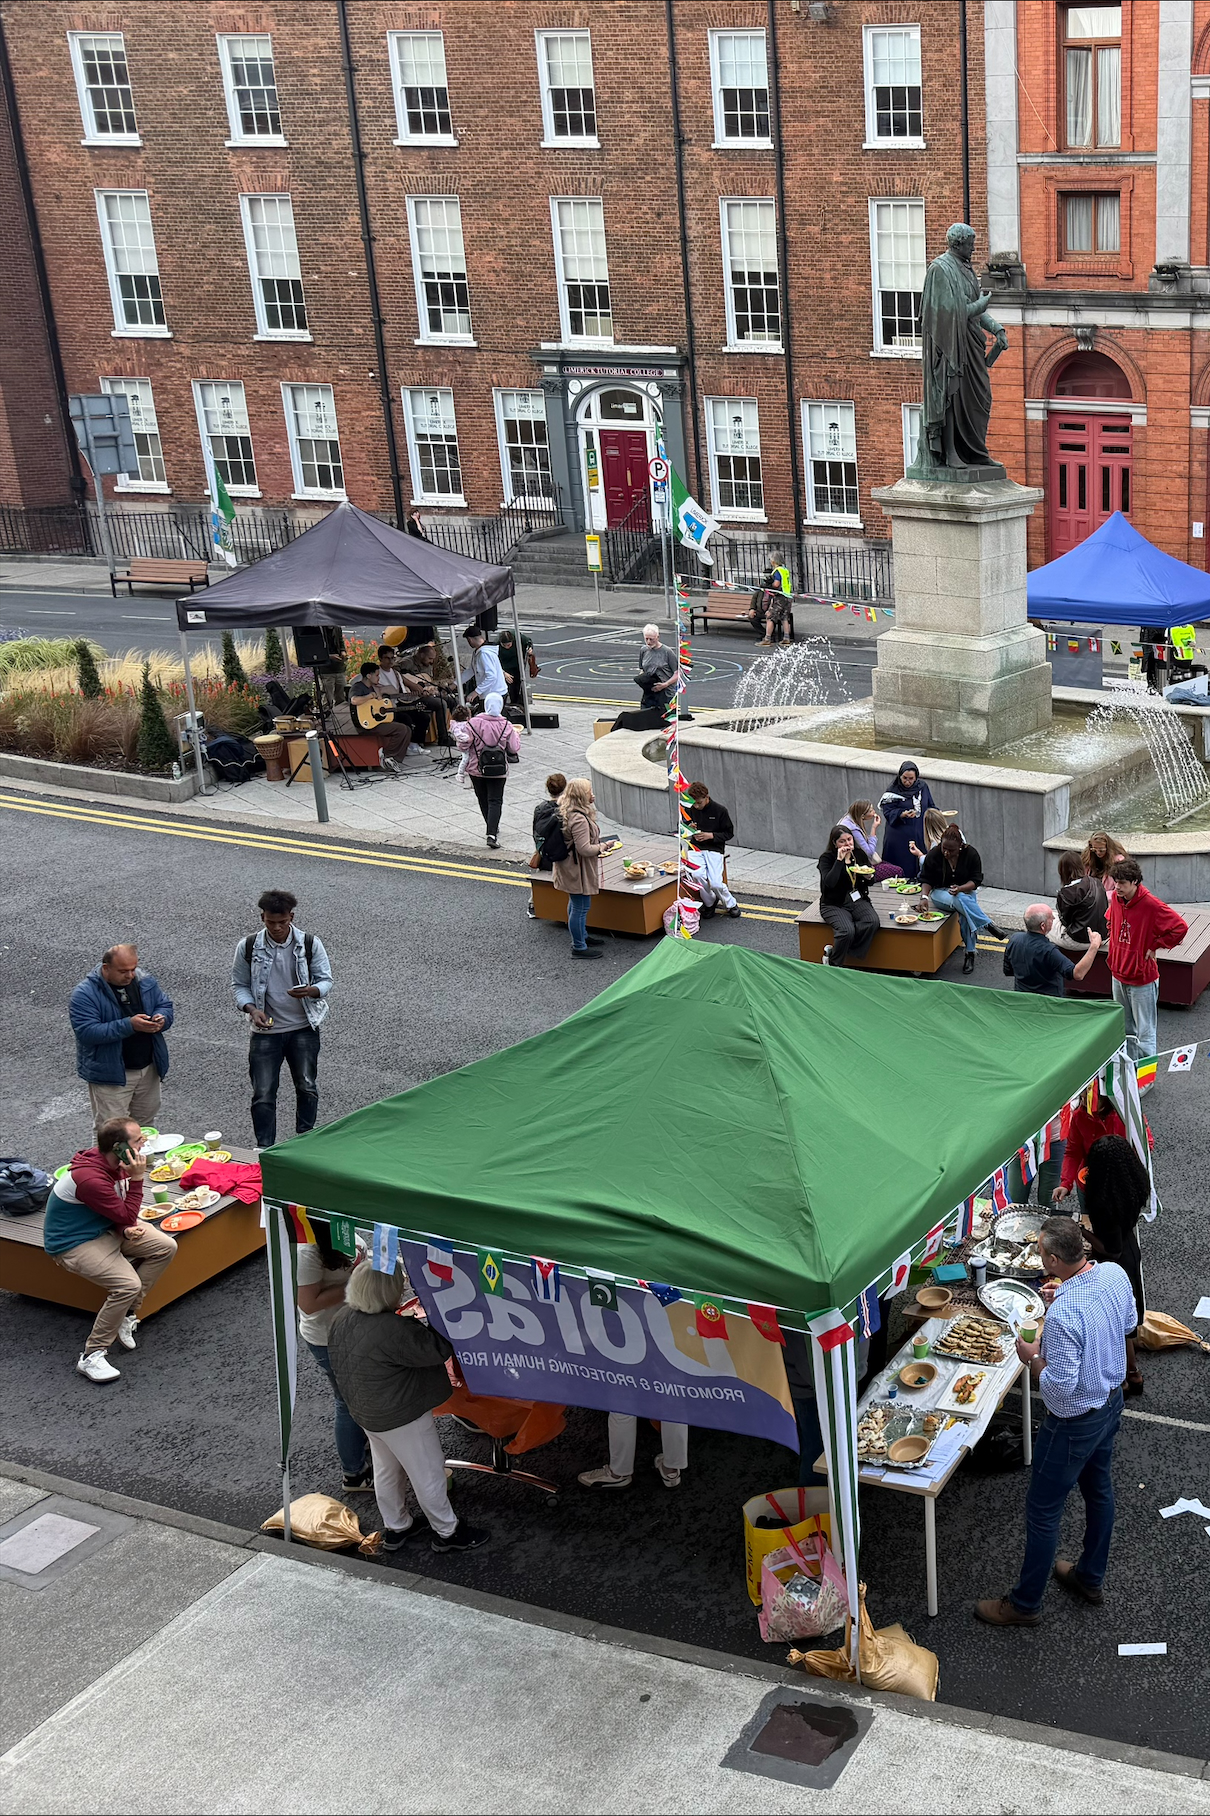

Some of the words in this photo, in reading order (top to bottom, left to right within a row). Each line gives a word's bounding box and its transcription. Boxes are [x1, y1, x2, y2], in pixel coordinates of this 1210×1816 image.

[565, 366, 595, 375] LIMERICK
[598, 367, 628, 376] TUTORIAL
[630, 367, 659, 377] COLLEGE
[654, 462, 663, 477] P
